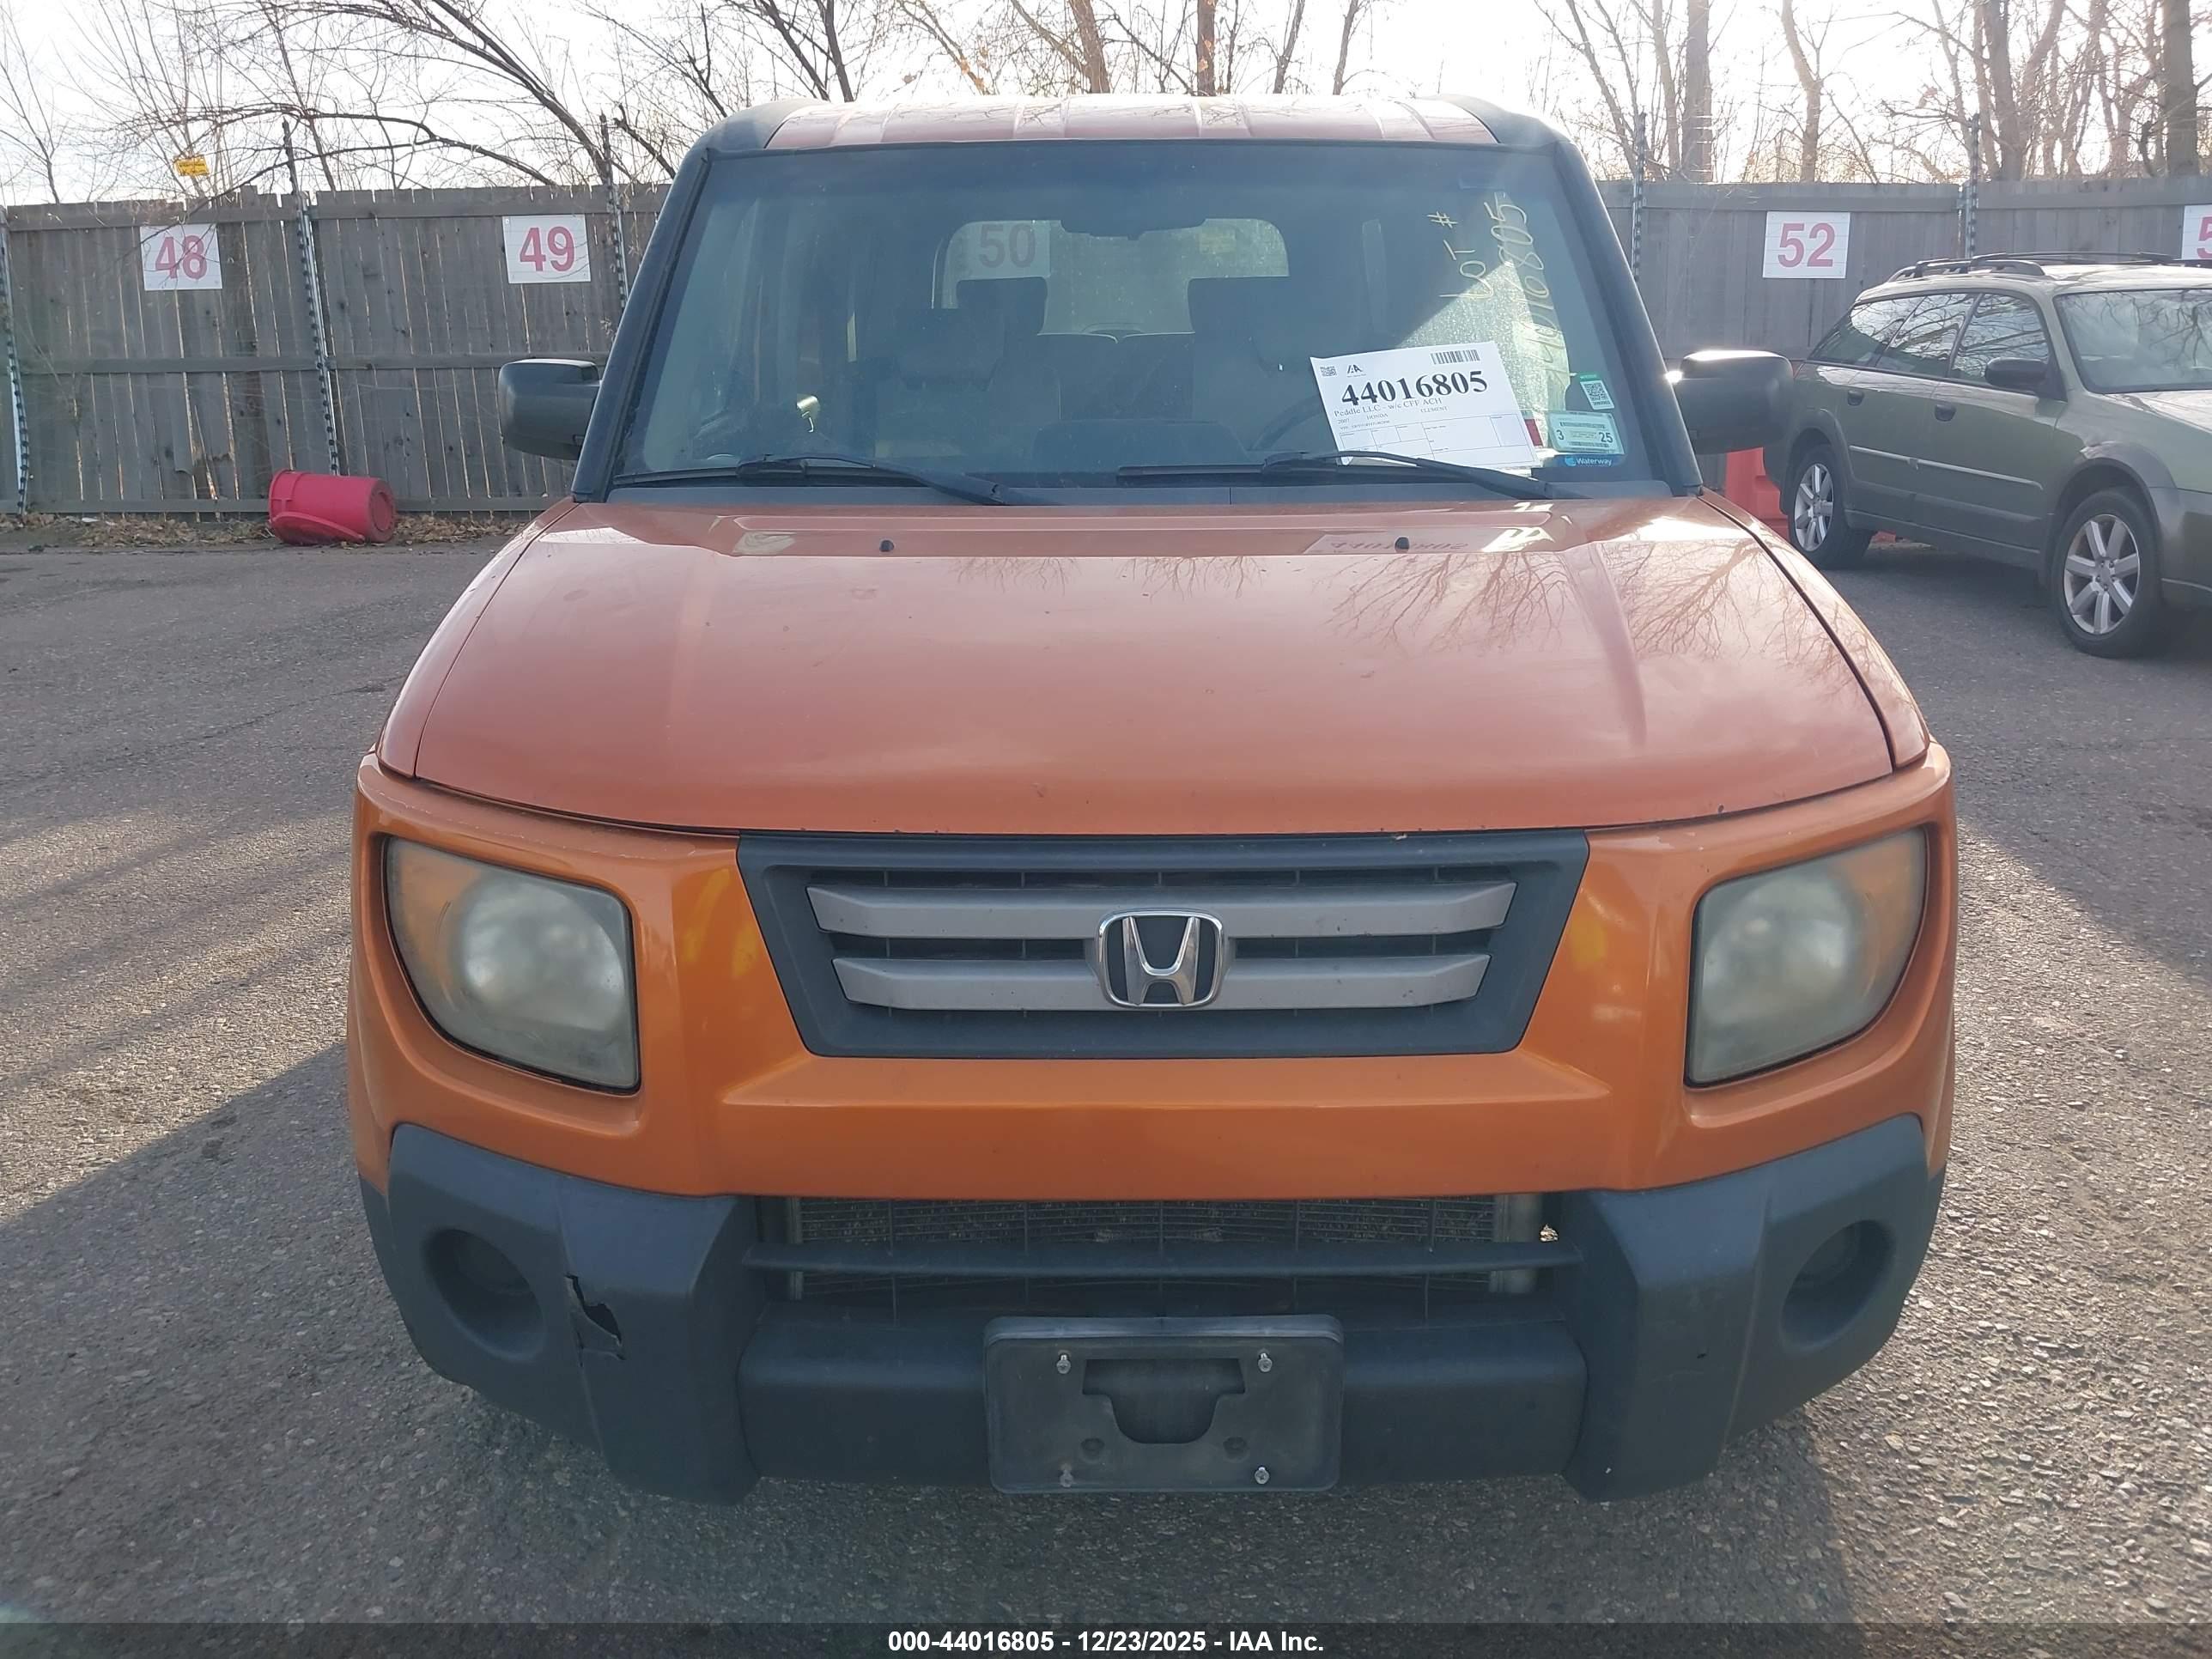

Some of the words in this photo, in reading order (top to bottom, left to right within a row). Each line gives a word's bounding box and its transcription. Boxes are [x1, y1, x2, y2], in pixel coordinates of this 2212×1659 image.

[1426, 211, 1458, 229] #
[154, 234, 208, 281] 48
[519, 226, 576, 272] 49
[977, 223, 1036, 269] 50
[1777, 222, 1836, 268] 52
[1341, 370, 1488, 406] 44016805
[1334, 406, 1361, 417] Peddle
[1362, 404, 1382, 413] LLC
[1556, 428, 1565, 441] 3
[1598, 431, 1613, 443] 25
[1576, 457, 1613, 466] Waterway
